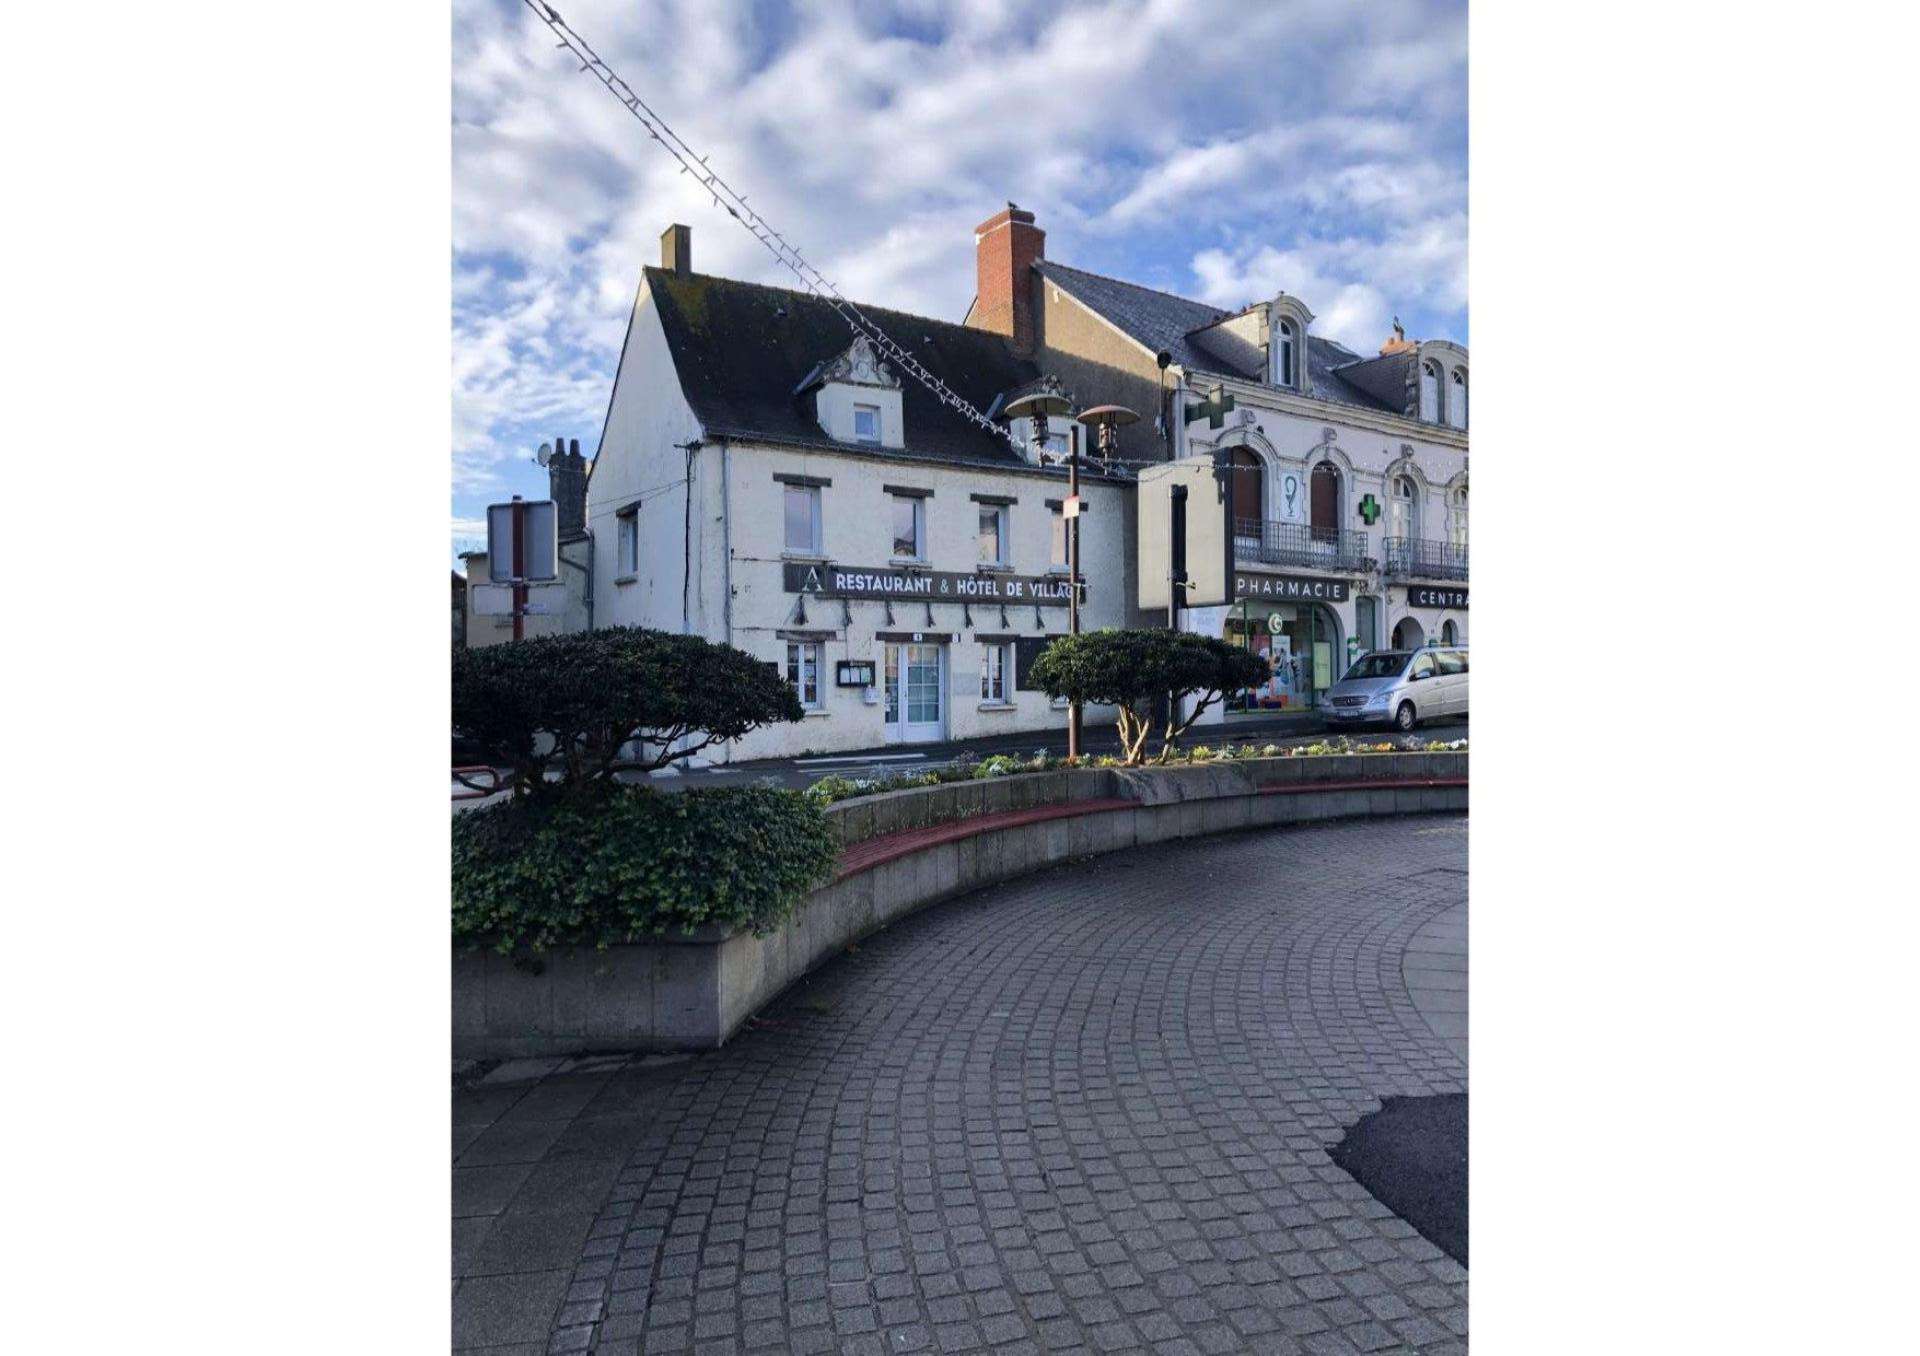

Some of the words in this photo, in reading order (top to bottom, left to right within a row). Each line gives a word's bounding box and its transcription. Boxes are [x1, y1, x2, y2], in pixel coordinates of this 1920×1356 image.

[836, 573, 933, 593] RESTAURANT
[940, 579, 949, 594] &
[957, 575, 1000, 596] HÔTEL
[1006, 581, 1023, 597] DE
[1237, 578, 1341, 598] PHARMACIE
